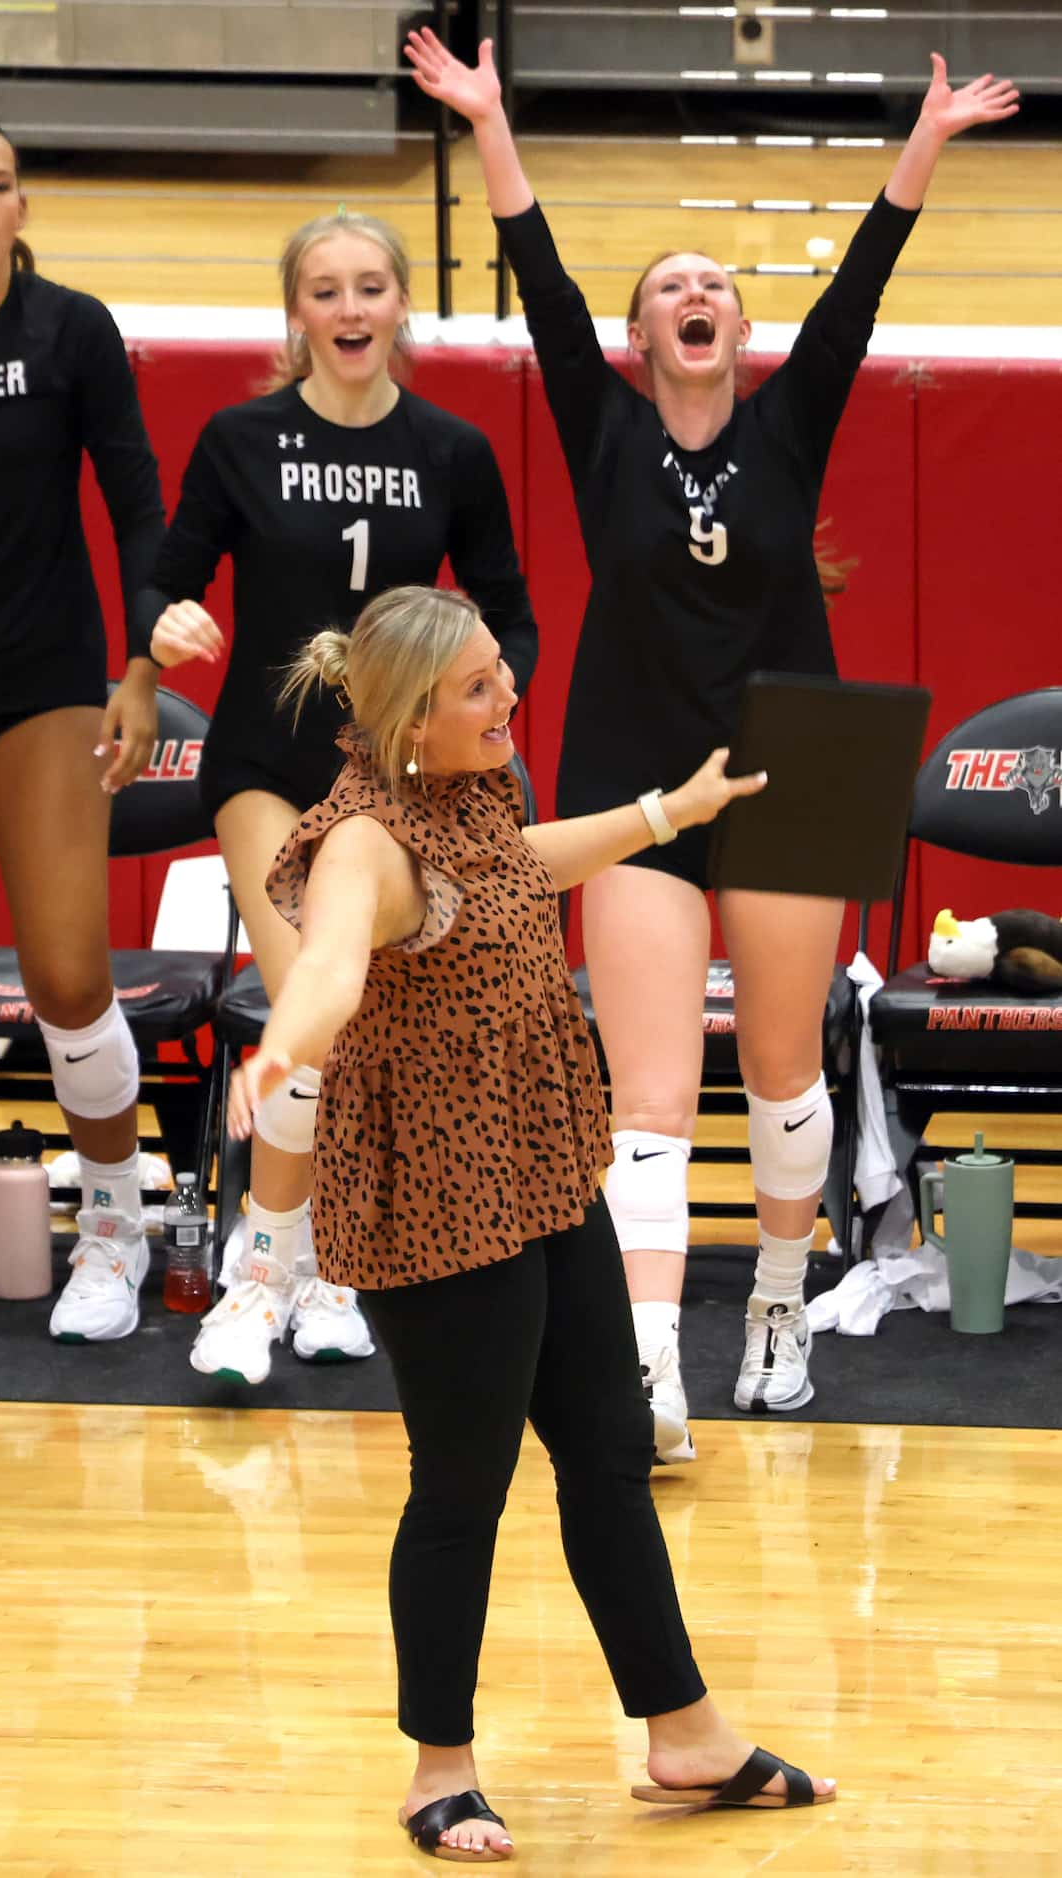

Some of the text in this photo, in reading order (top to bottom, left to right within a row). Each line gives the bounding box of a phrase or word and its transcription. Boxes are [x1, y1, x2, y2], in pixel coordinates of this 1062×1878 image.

[280, 461, 422, 509] PROSPER
[341, 518, 370, 592] 1
[945, 748, 1020, 791] THE
